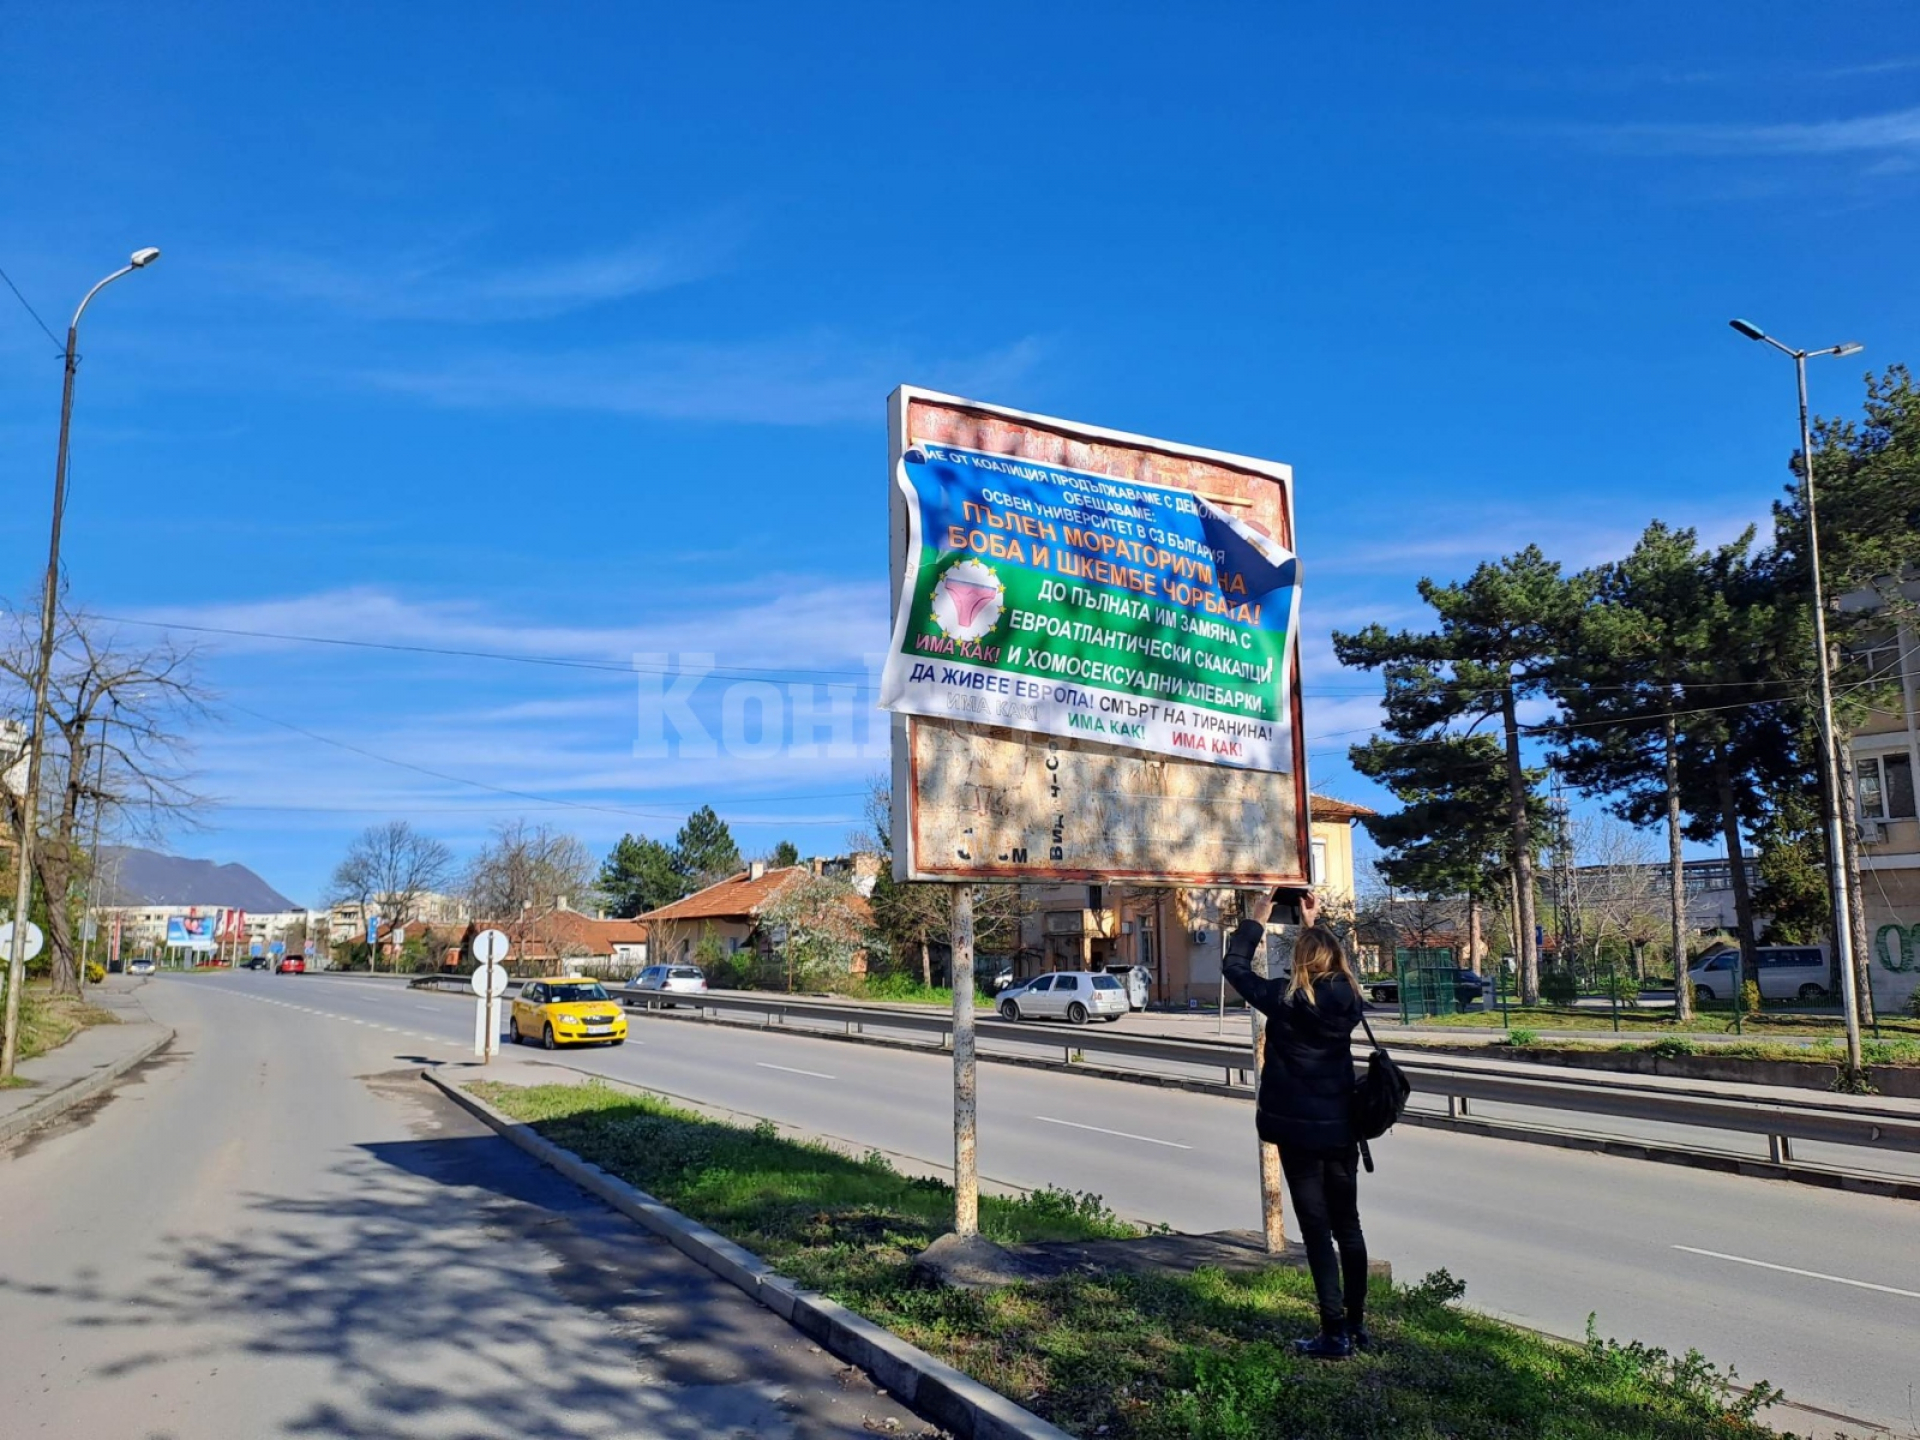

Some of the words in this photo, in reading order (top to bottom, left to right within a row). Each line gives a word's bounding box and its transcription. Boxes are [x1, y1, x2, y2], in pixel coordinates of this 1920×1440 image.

[949, 453, 970, 465] ОТ
[971, 457, 1049, 483] КОАЛИЦИЯ
[1051, 473, 1163, 506] ПРОДЪЛЖАВАМЕ
[1164, 495, 1173, 510] С
[1063, 491, 1158, 523] ОБЕЩАВАМЕ:
[981, 488, 1033, 512] ОСВЕН
[1034, 502, 1133, 536] УНИВЕРСИТЕТ
[1136, 525, 1147, 538] В
[948, 525, 1025, 564] БОБА
[1031, 544, 1050, 570] И
[1056, 551, 1158, 598] ШКЕМБЕ
[1163, 577, 1262, 625] ЧОРБАТА!
[962, 501, 1058, 542] ПЪЛЕН
[1062, 525, 1214, 586] МОРАТОРИУМ
[1217, 569, 1248, 596] НА
[1008, 609, 1191, 665] ЕВРОАТЛАНТИЧЕСКИ
[1037, 579, 1067, 603] ДО
[1070, 586, 1151, 622] ПЪЛНАТА
[1155, 606, 1178, 629] ИМ
[1180, 614, 1238, 645] ЗАМЯНА
[1240, 632, 1252, 649] С
[915, 632, 955, 655] ИМА
[959, 640, 1000, 664] КАК!
[909, 662, 936, 684] ДА
[941, 666, 1010, 695] ЖИВЕЕ
[1014, 679, 1095, 709] ЕВРОПА!
[1099, 696, 1160, 721] СМЪРТ
[1163, 706, 1186, 726] НА
[1192, 712, 1273, 741] ТИРАНИНА!
[946, 691, 992, 716] ИМА
[995, 698, 1039, 722] КАК!
[1006, 644, 1022, 666] И
[1024, 648, 1184, 698] ХОМОСЕКСУАЛНИ
[1186, 680, 1268, 714] ХЛЕБАРКИ.
[1067, 711, 1106, 732] ИМА
[1109, 719, 1146, 740] КАК!
[1171, 730, 1208, 751] ИМА
[1211, 738, 1244, 757] КАК!
